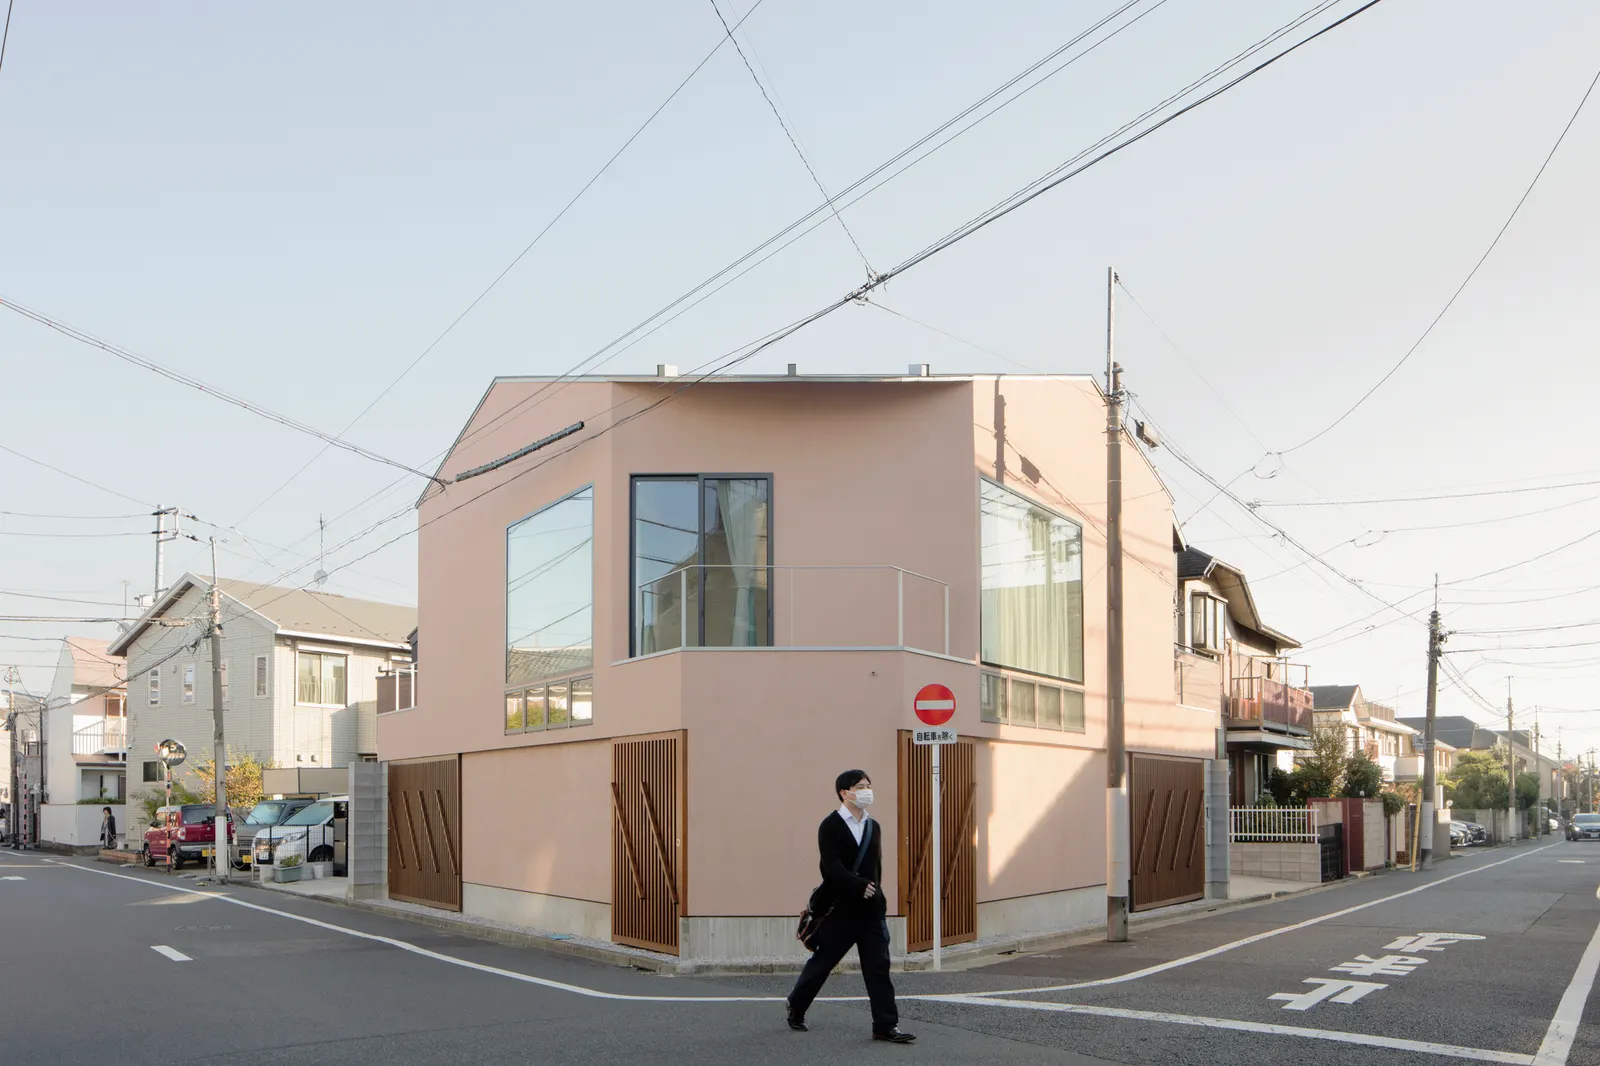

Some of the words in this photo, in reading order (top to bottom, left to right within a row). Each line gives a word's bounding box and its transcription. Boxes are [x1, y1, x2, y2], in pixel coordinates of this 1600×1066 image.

[916, 731, 953, 741] 自転車を除く
[1266, 932, 1487, 1011] 止まれ
